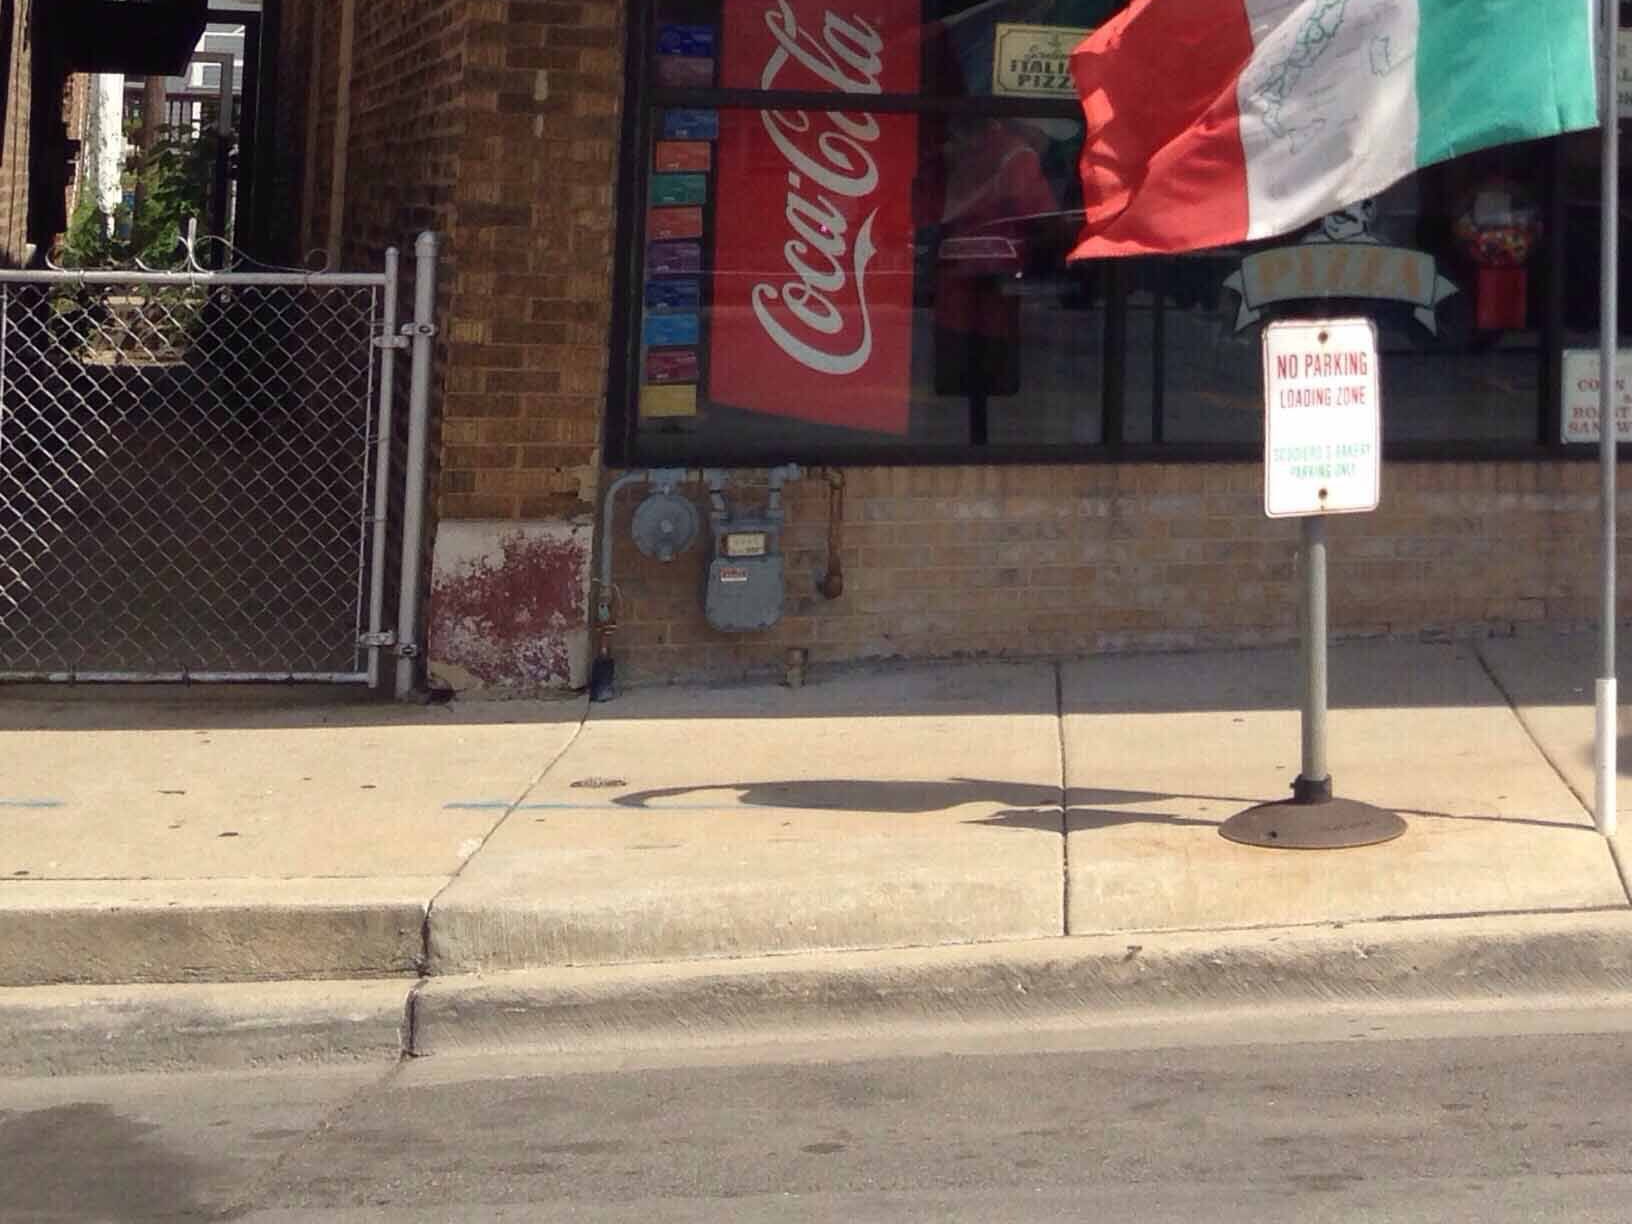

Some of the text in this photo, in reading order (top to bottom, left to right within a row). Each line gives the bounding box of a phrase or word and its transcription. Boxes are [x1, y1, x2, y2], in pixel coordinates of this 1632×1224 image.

[1008, 59, 1071, 74] ITALI
[1017, 74, 1073, 89] PIZZ
[1276, 352, 1369, 380] NO PARKING
[1577, 377, 1625, 392] CON
[1280, 385, 1366, 409] LOADING ZONE
[1572, 407, 1631, 419] ROT
